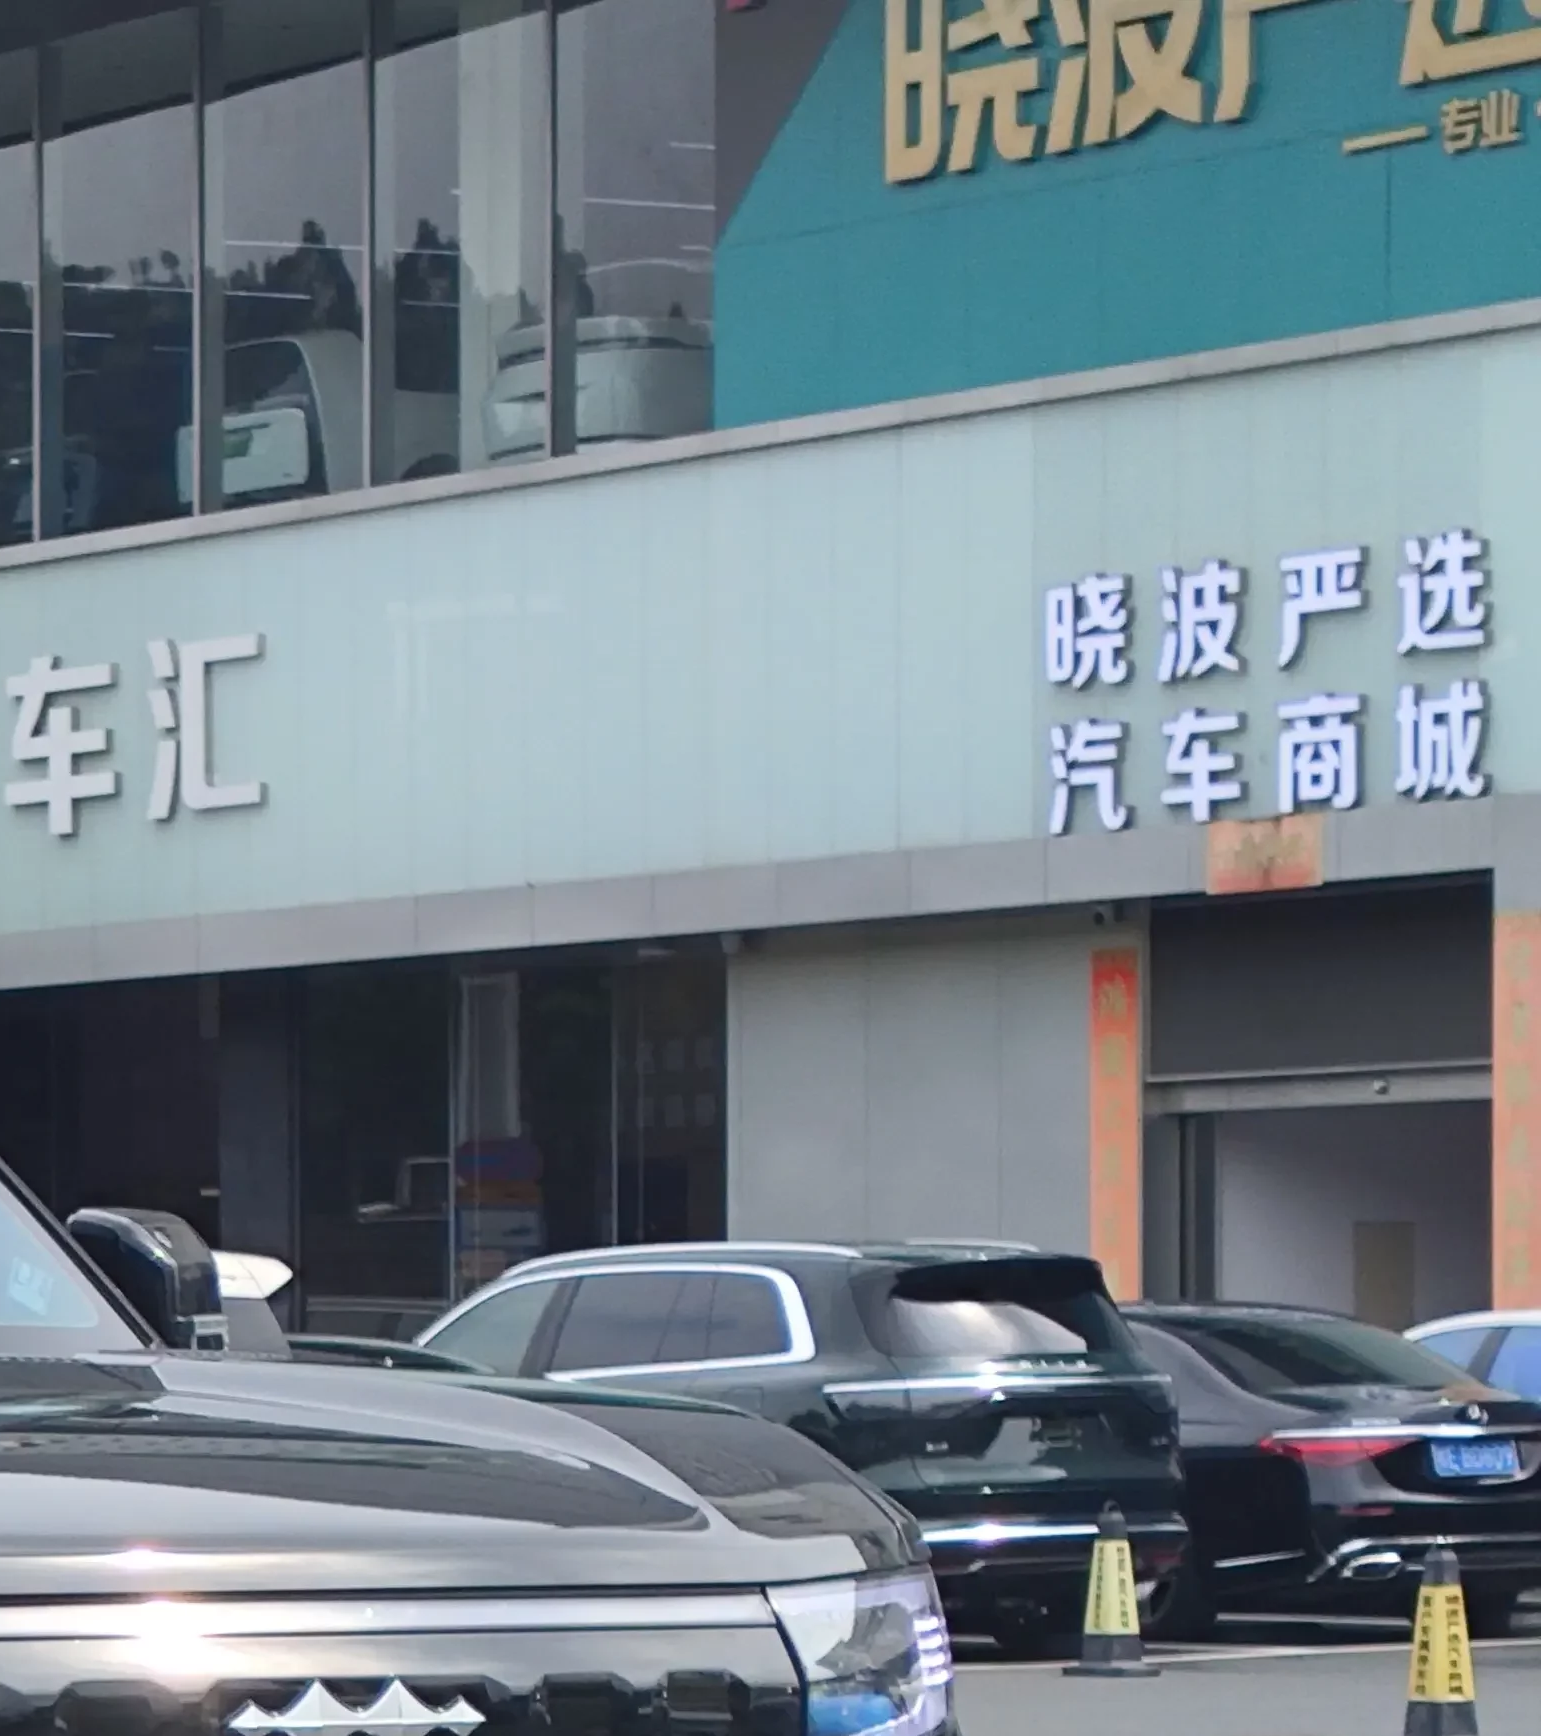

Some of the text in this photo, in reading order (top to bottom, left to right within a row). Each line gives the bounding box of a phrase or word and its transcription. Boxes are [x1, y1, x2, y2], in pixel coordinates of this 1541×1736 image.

[1441, 89, 1523, 155] 专业
[1044, 529, 1485, 690] 晓波严选
[1049, 680, 1485, 836] 汽车商城
